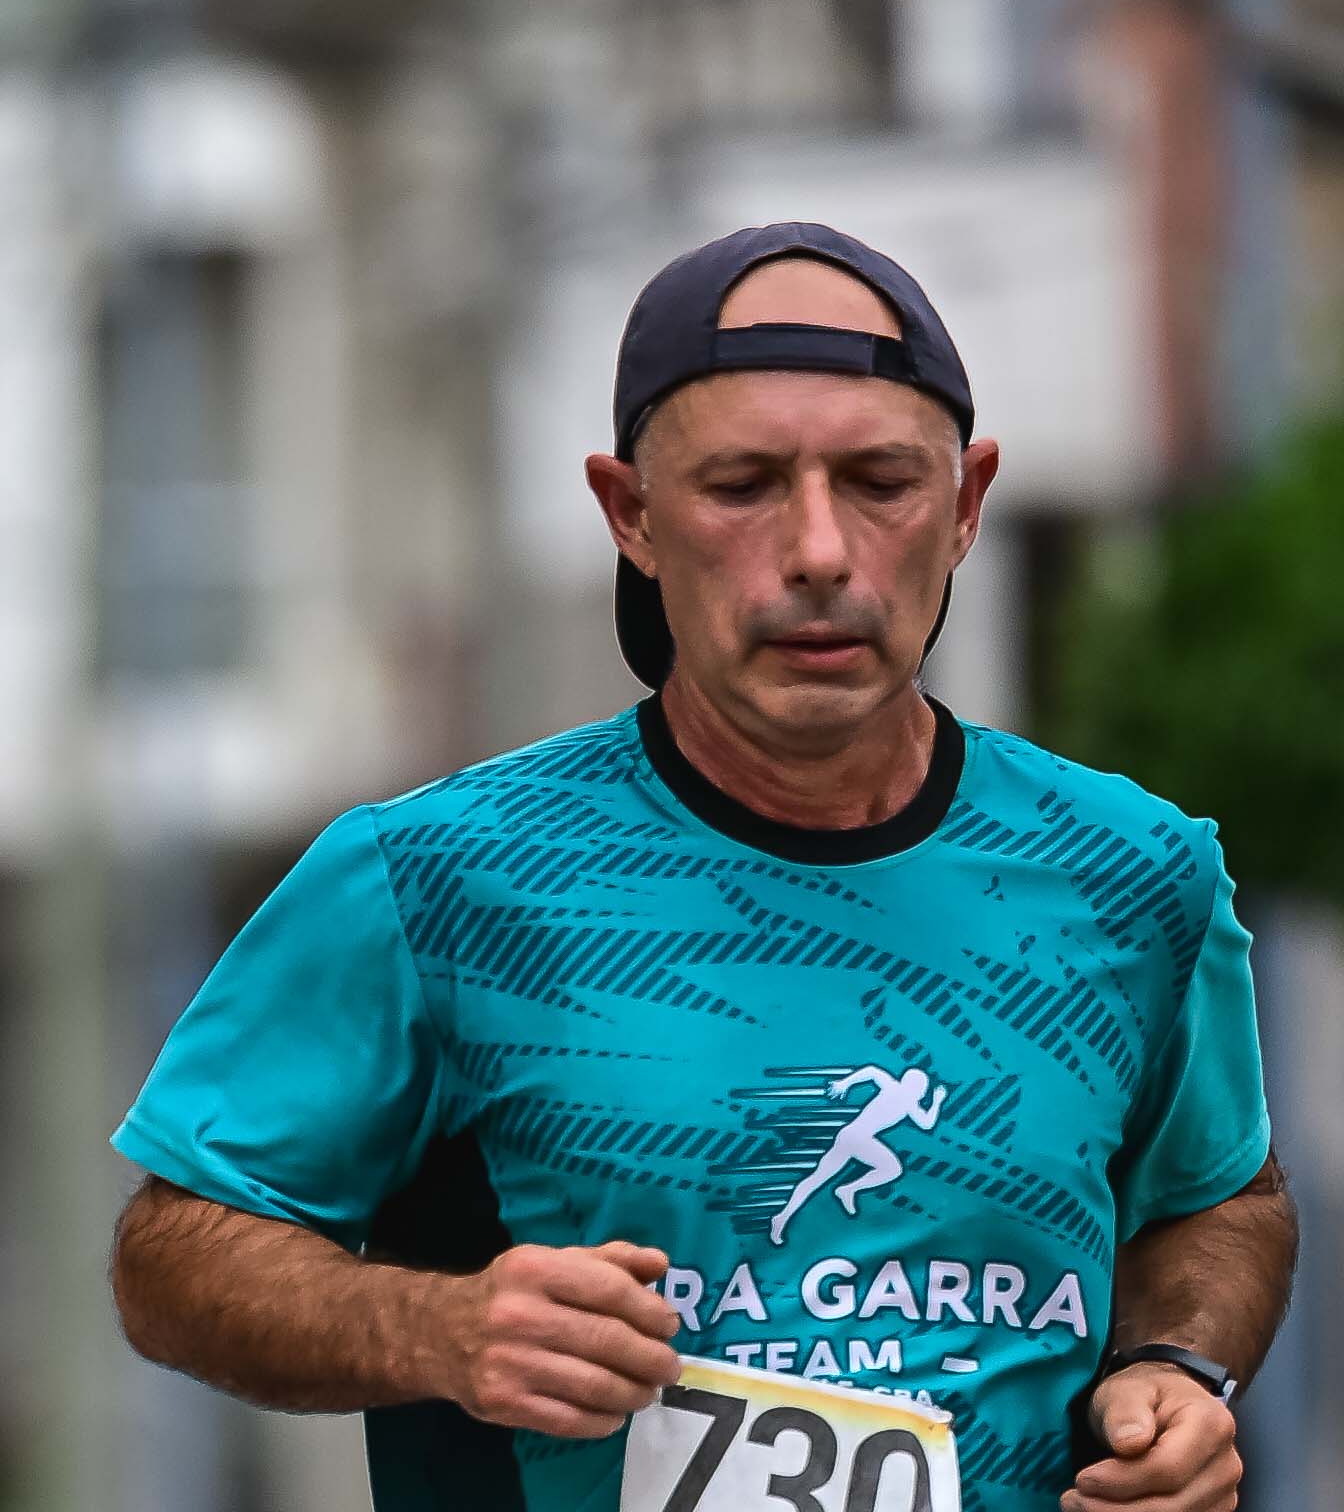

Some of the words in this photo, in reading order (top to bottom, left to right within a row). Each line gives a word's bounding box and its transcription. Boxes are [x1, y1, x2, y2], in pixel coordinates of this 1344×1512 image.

[647, 1265, 769, 1332] RA
[802, 1257, 1088, 1339] GARRA
[725, 1339, 902, 1378] TEAM
